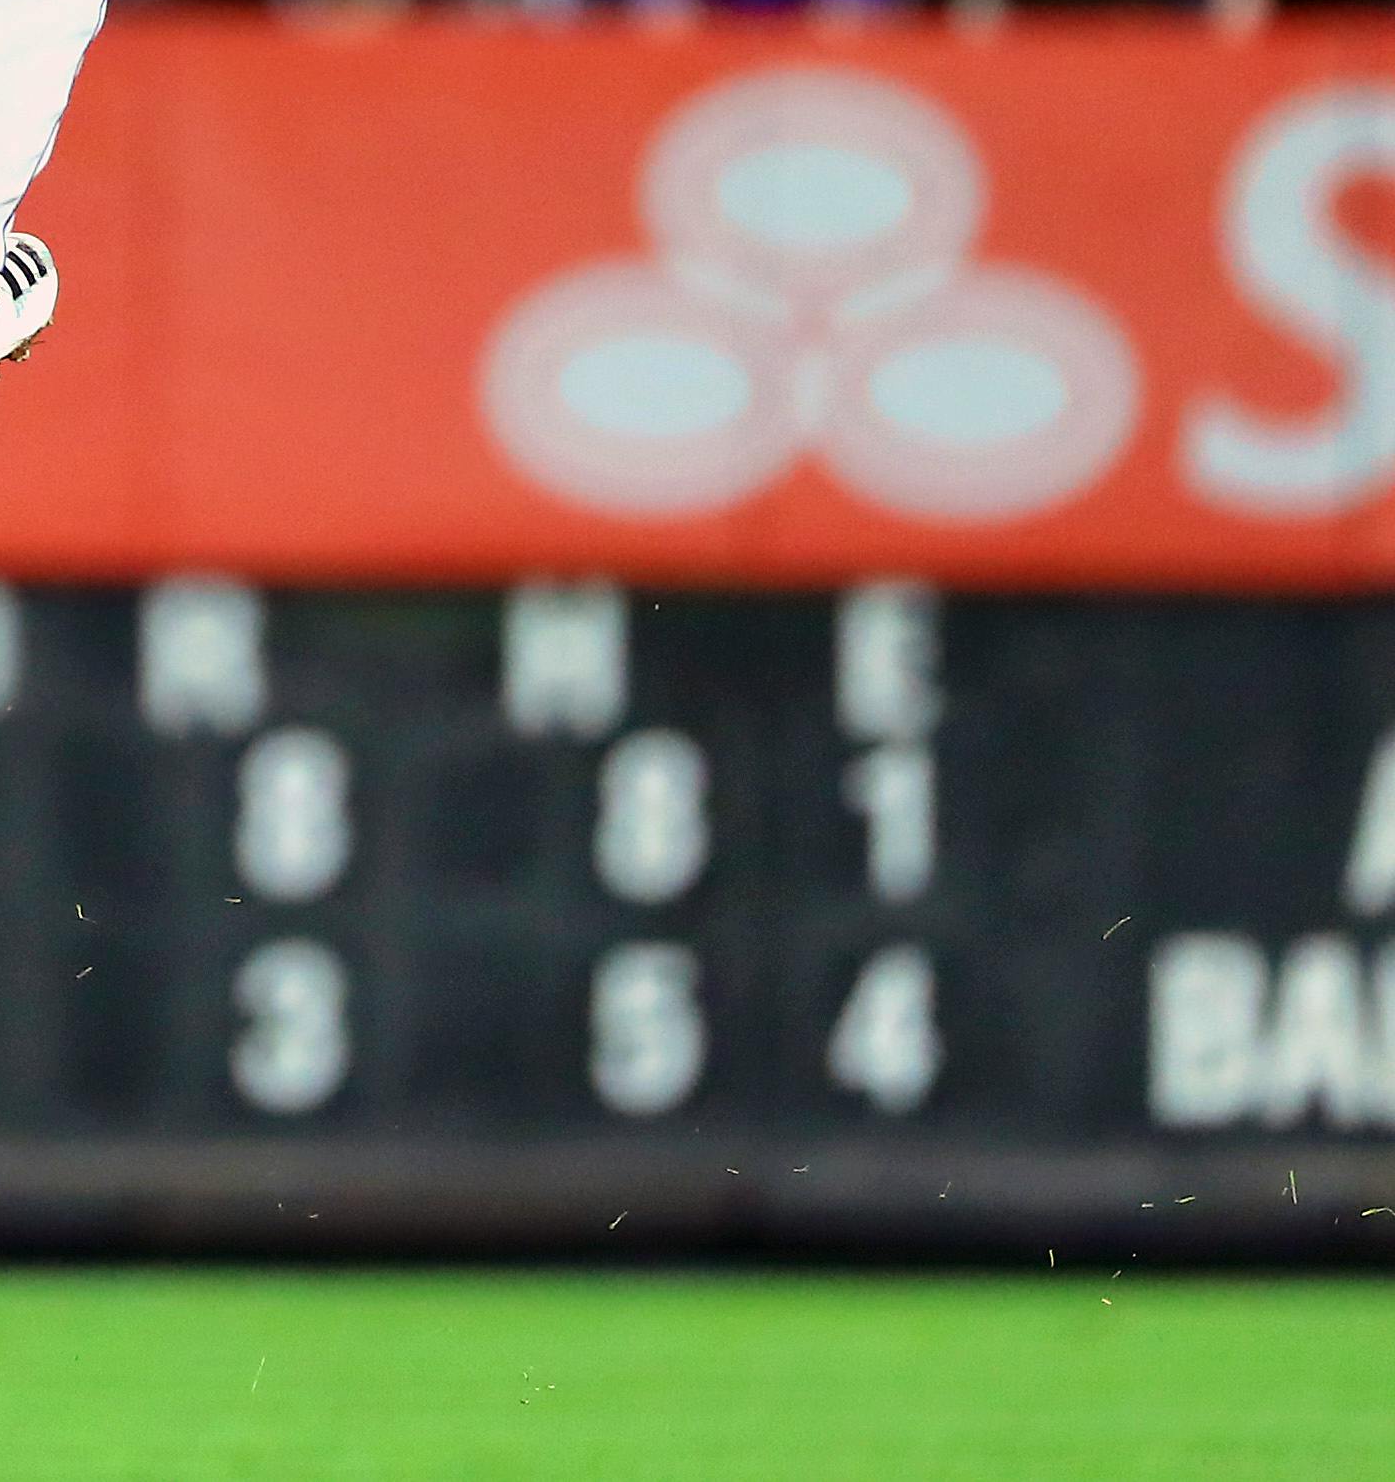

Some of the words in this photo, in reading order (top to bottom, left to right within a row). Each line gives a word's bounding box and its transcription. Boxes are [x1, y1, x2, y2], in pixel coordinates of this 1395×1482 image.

[847, 734, 934, 898] 1
[233, 940, 347, 1110] 3
[831, 946, 939, 1108] 4
[1149, 932, 1395, 1125] BA
